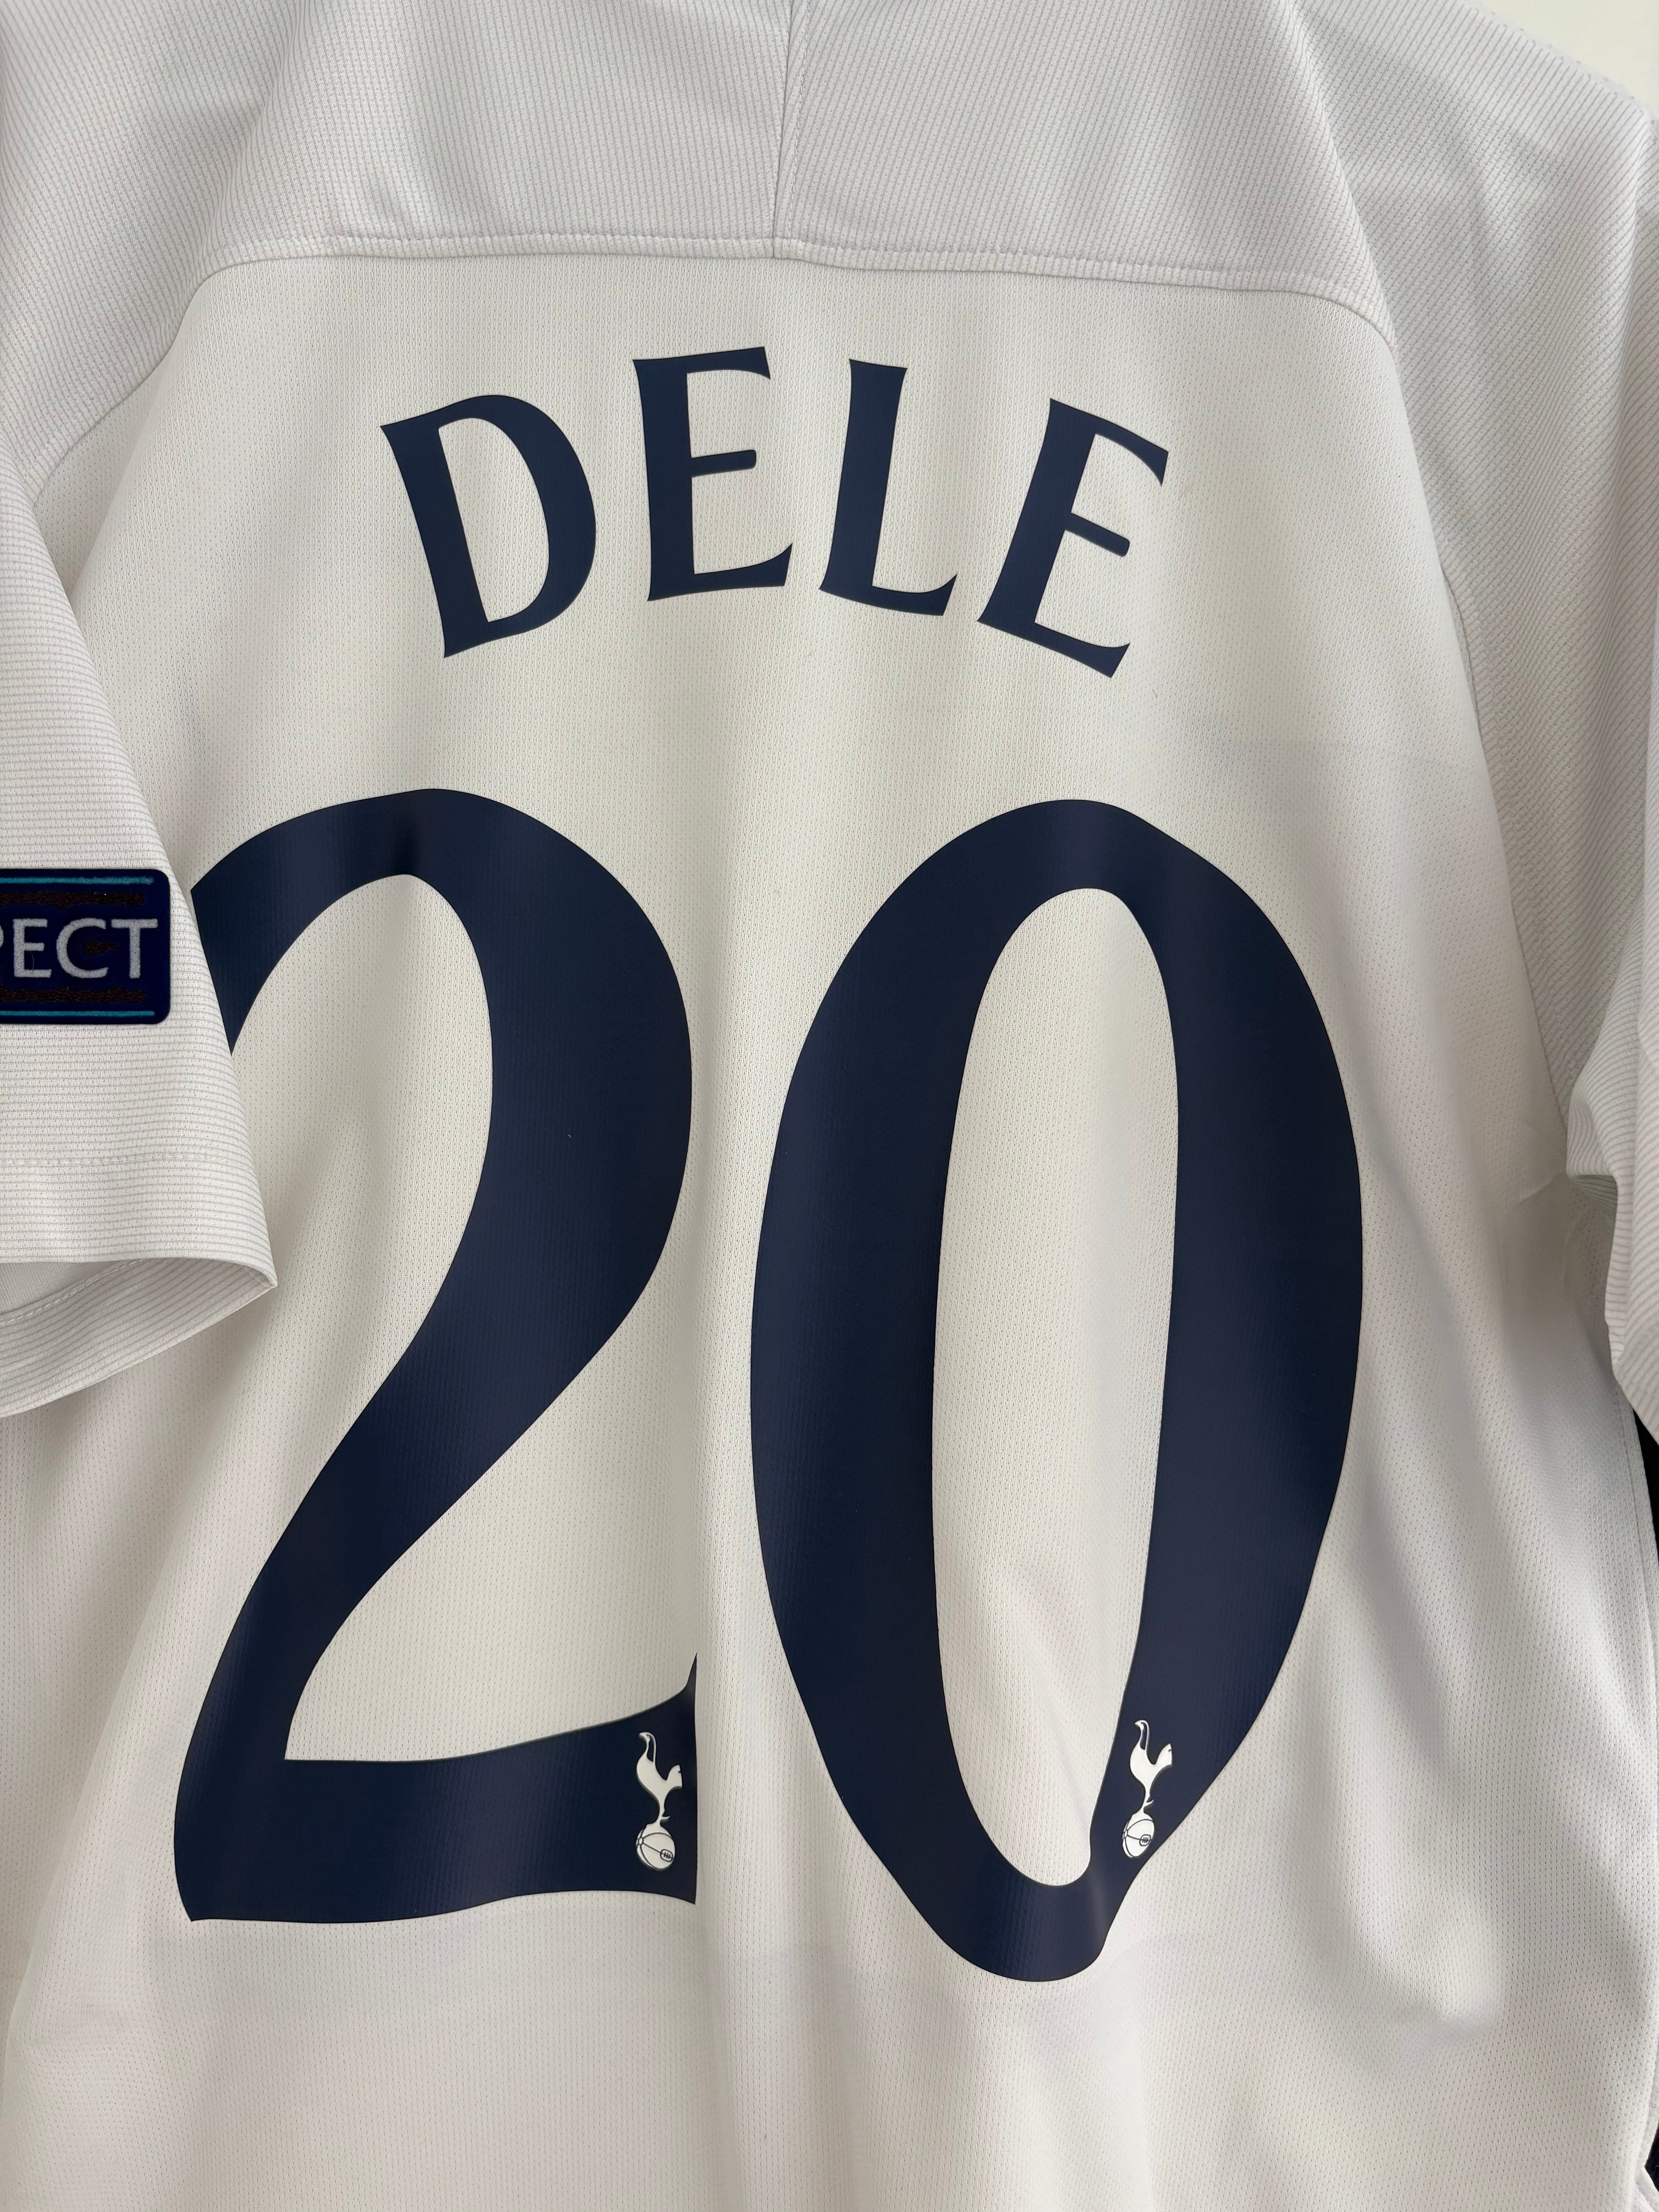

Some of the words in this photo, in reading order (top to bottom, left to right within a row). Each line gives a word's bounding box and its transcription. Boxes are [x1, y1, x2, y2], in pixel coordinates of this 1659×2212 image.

[380, 346, 1169, 678] DELE
[0, 918, 158, 979] ECT
[173, 788, 1363, 1982] 20
